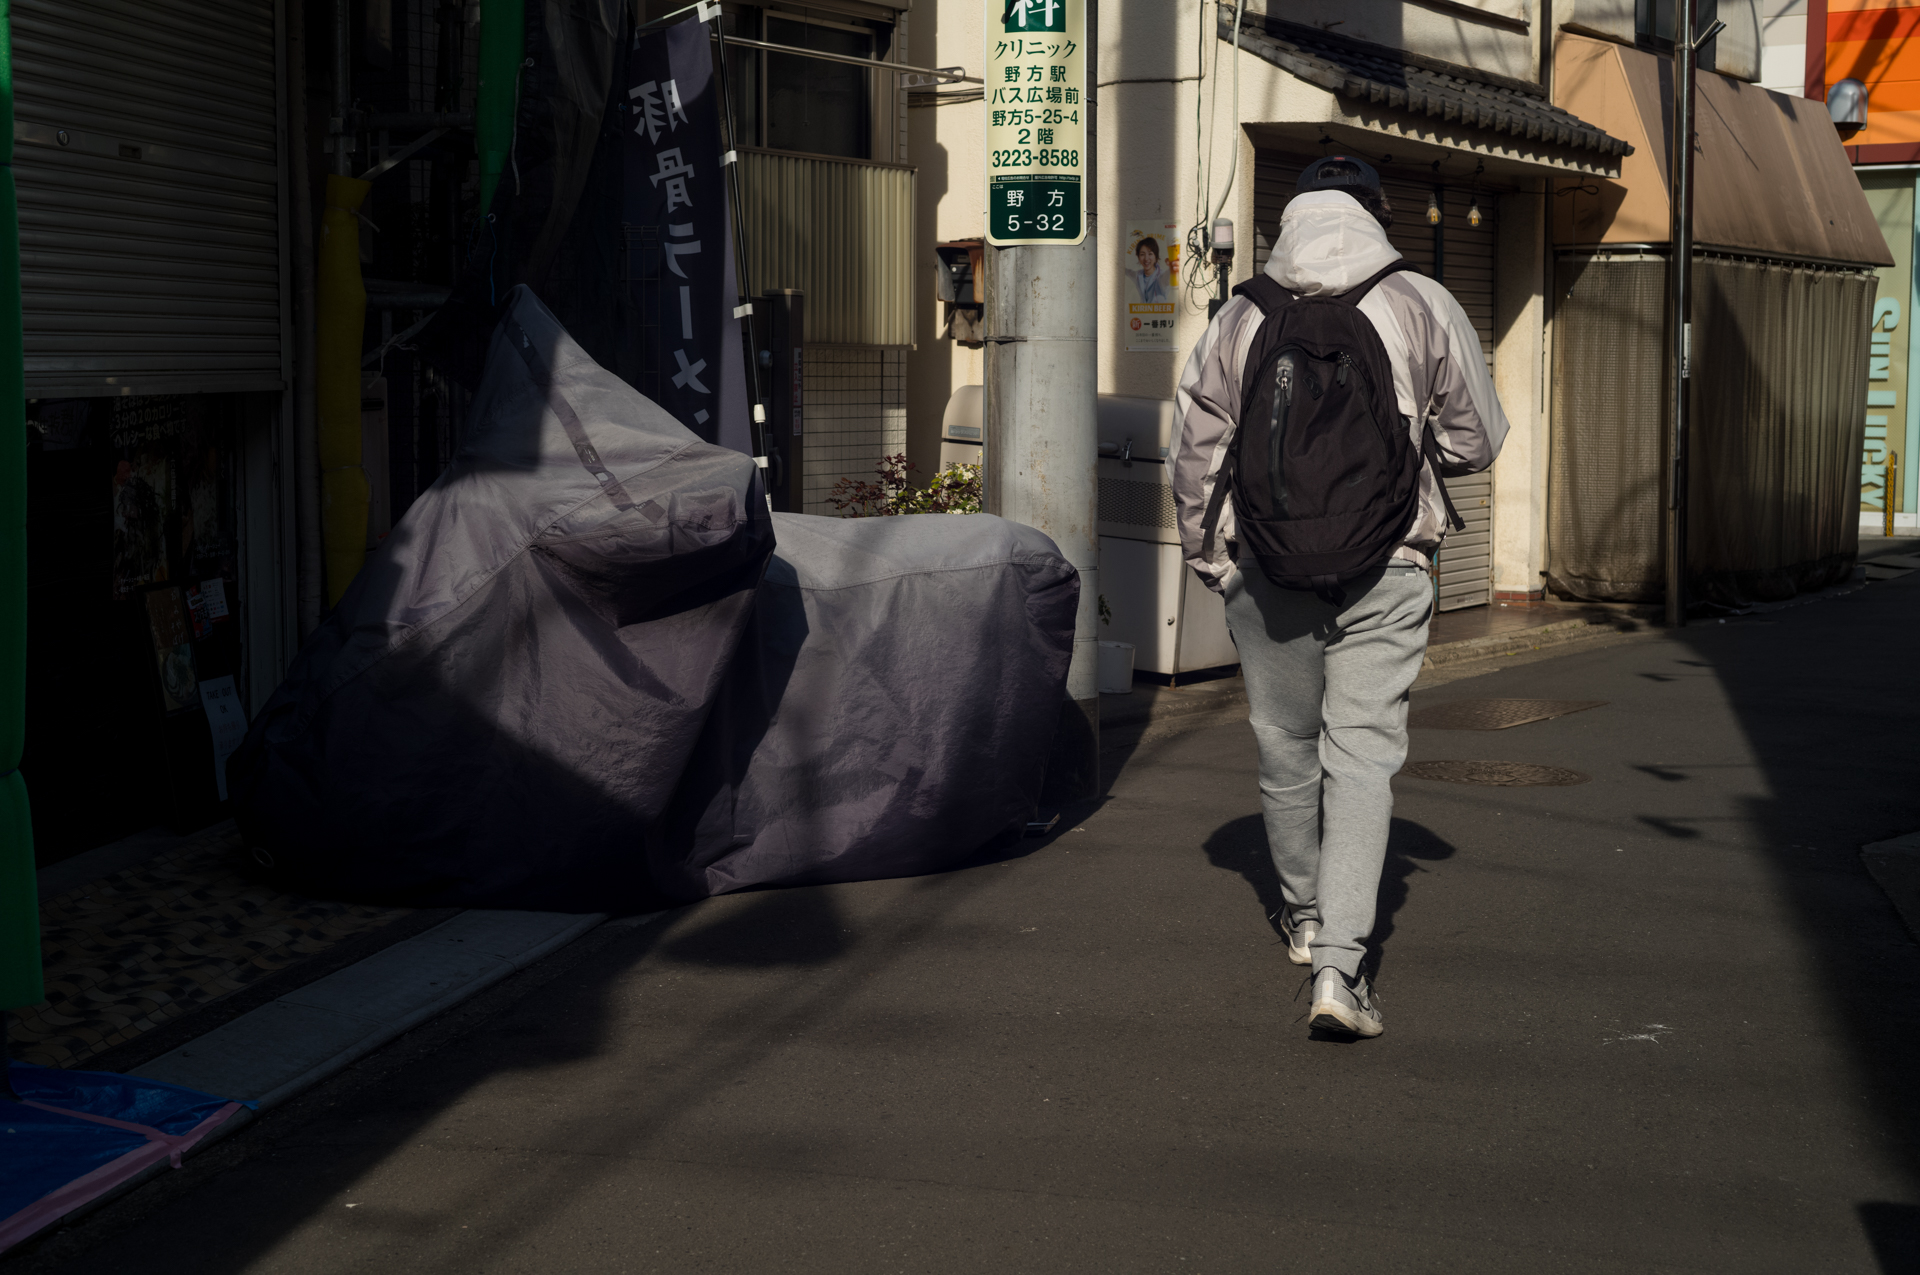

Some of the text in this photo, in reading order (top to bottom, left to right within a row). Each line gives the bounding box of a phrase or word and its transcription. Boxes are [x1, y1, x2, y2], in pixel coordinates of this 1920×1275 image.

[994, 39, 1077, 60] クリニック
[1004, 65, 1066, 82] 野方駅
[992, 86, 1079, 104] バス広場前
[992, 110, 1078, 126] 野方5-25-4
[1017, 128, 1054, 145] 2階
[992, 149, 1079, 167] 3223-8588
[1007, 189, 1065, 207] 野方
[1008, 214, 1064, 231] 5-32
[1131, 304, 1173, 313] KIRIN BEER
[1143, 319, 1175, 329] 一番搾り
[206, 686, 231, 700] TAKE OUT
[220, 704, 228, 713] OK
